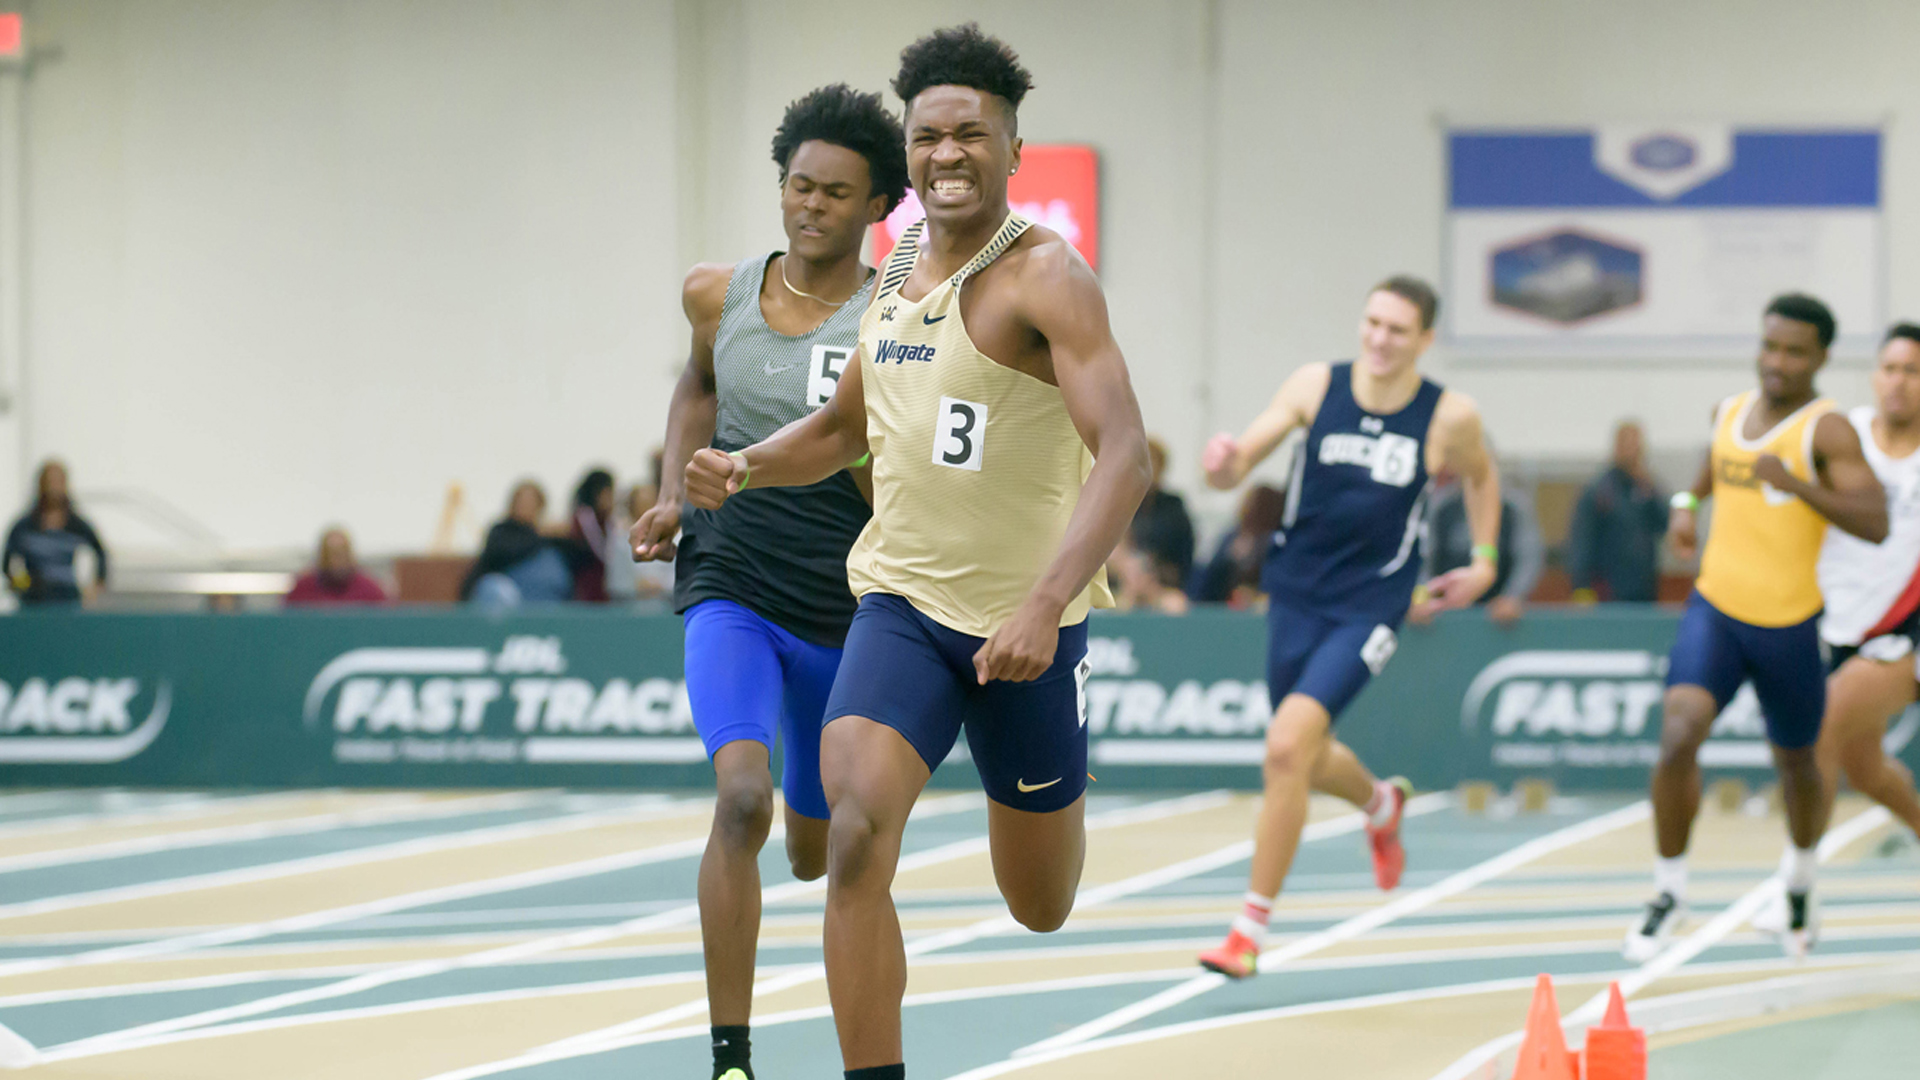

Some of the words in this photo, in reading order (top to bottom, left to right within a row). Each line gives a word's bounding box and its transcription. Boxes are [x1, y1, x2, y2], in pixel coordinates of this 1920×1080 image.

[819, 350, 847, 404] 5
[942, 403, 976, 465] 3
[0, 677, 138, 732] ACK
[334, 677, 502, 732] FAST
[1493, 680, 1664, 735] FAST
